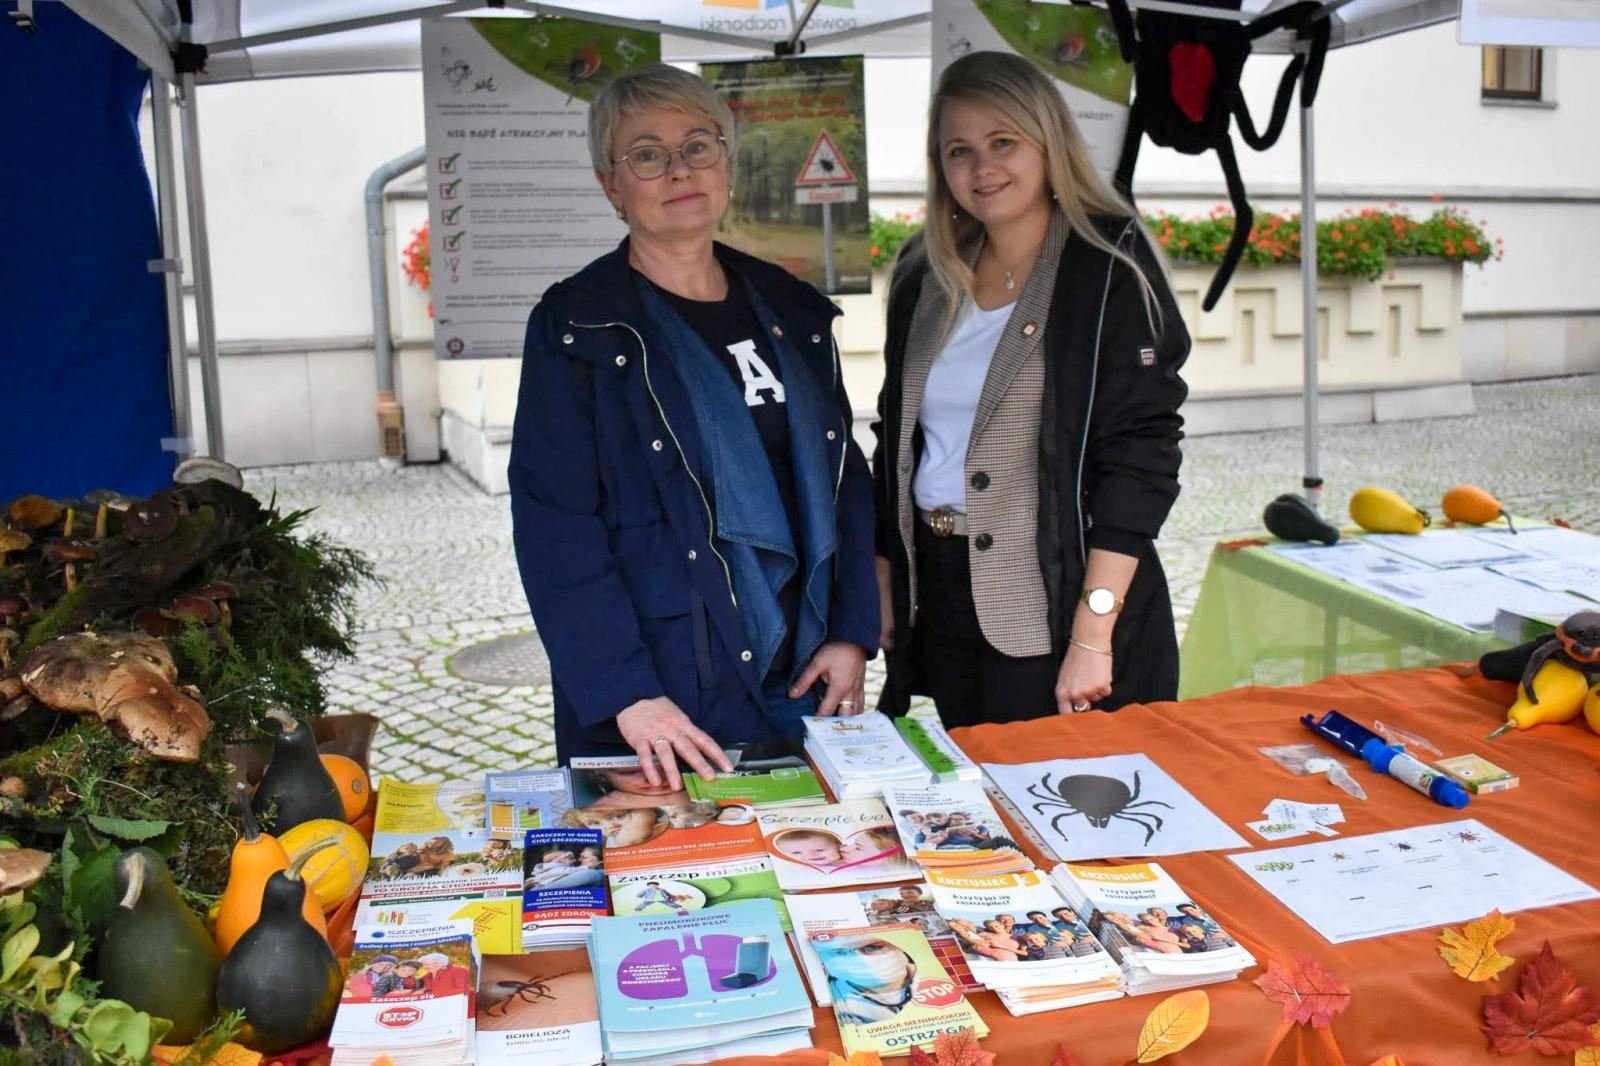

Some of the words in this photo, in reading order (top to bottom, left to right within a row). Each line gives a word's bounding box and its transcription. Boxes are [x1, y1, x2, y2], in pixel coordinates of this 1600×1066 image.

[447, 130, 466, 138] NIE
[500, 130, 564, 138] ATRAKCYJNY
[726, 339, 786, 406] A
[618, 872, 700, 883] Zaszczep
[936, 876, 1009, 887] KRZTUSIEC
[638, 913, 730, 927] PNEUMOKOKOWE
[388, 924, 455, 936] SZCZEPIENIA
[643, 922, 700, 932] ZAPALENIE
[914, 982, 956, 1003] STOP
[866, 1022, 904, 1034] UWAGA
[904, 1011, 971, 1027] MENINGOKOKI
[506, 1028, 570, 1040] BORELIOZA
